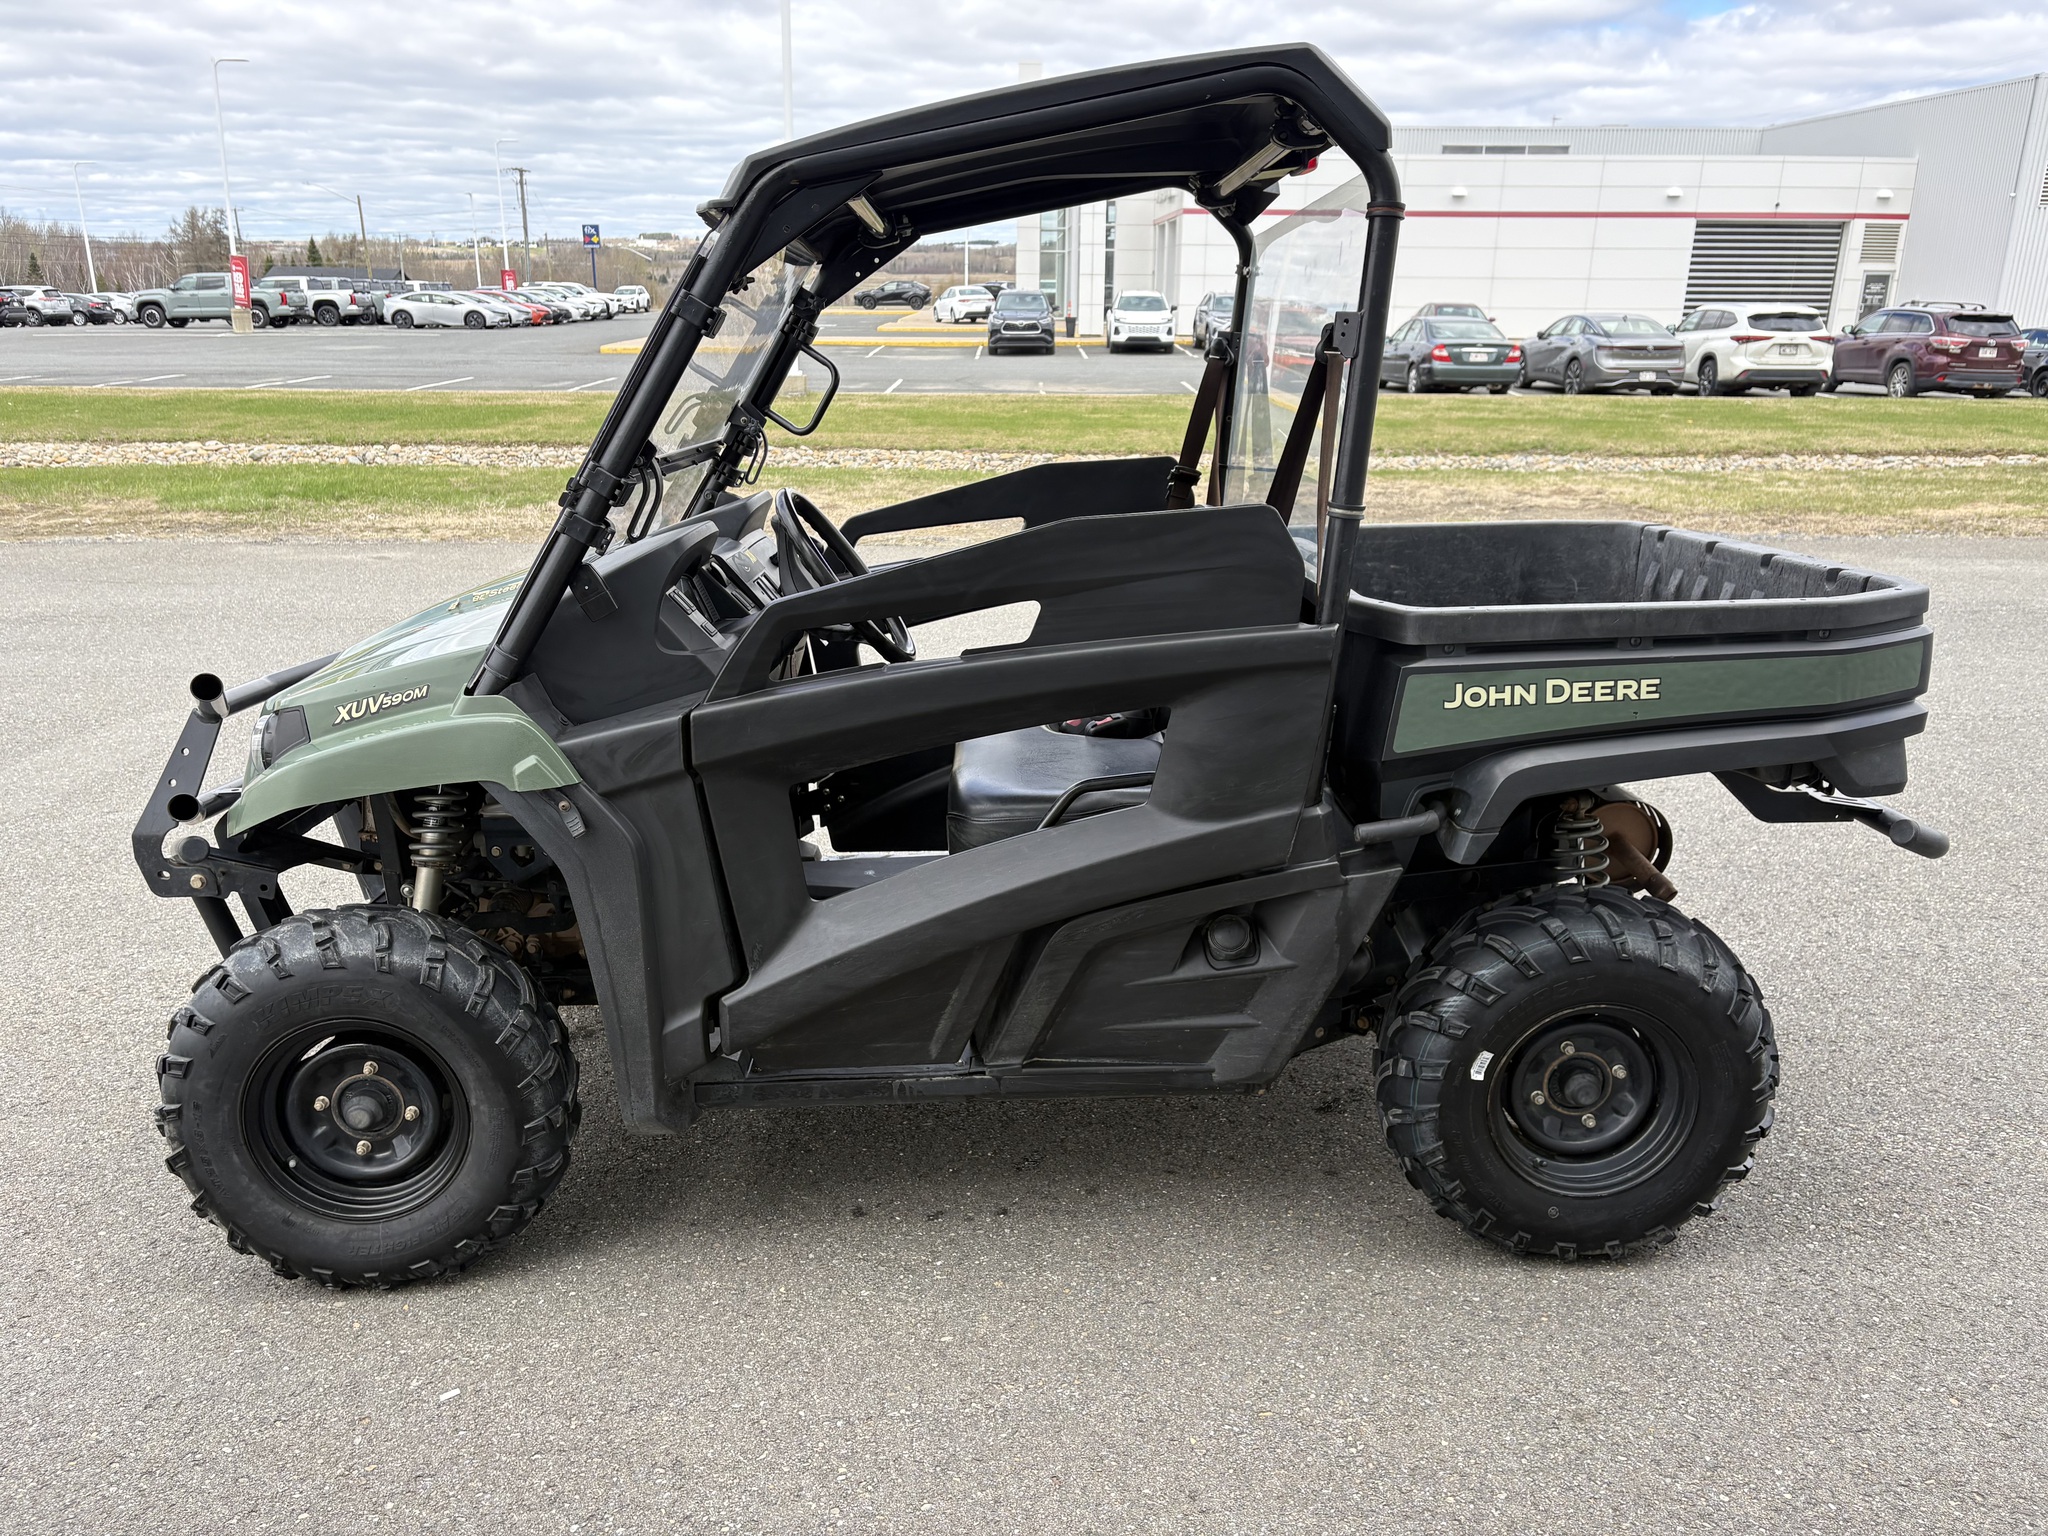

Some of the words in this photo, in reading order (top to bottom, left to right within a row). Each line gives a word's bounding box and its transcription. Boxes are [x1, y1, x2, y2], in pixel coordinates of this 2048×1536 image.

[332, 683, 430, 726] XUV590M
[1443, 682, 1538, 710] JOHN
[1545, 677, 1662, 705] DEERE
